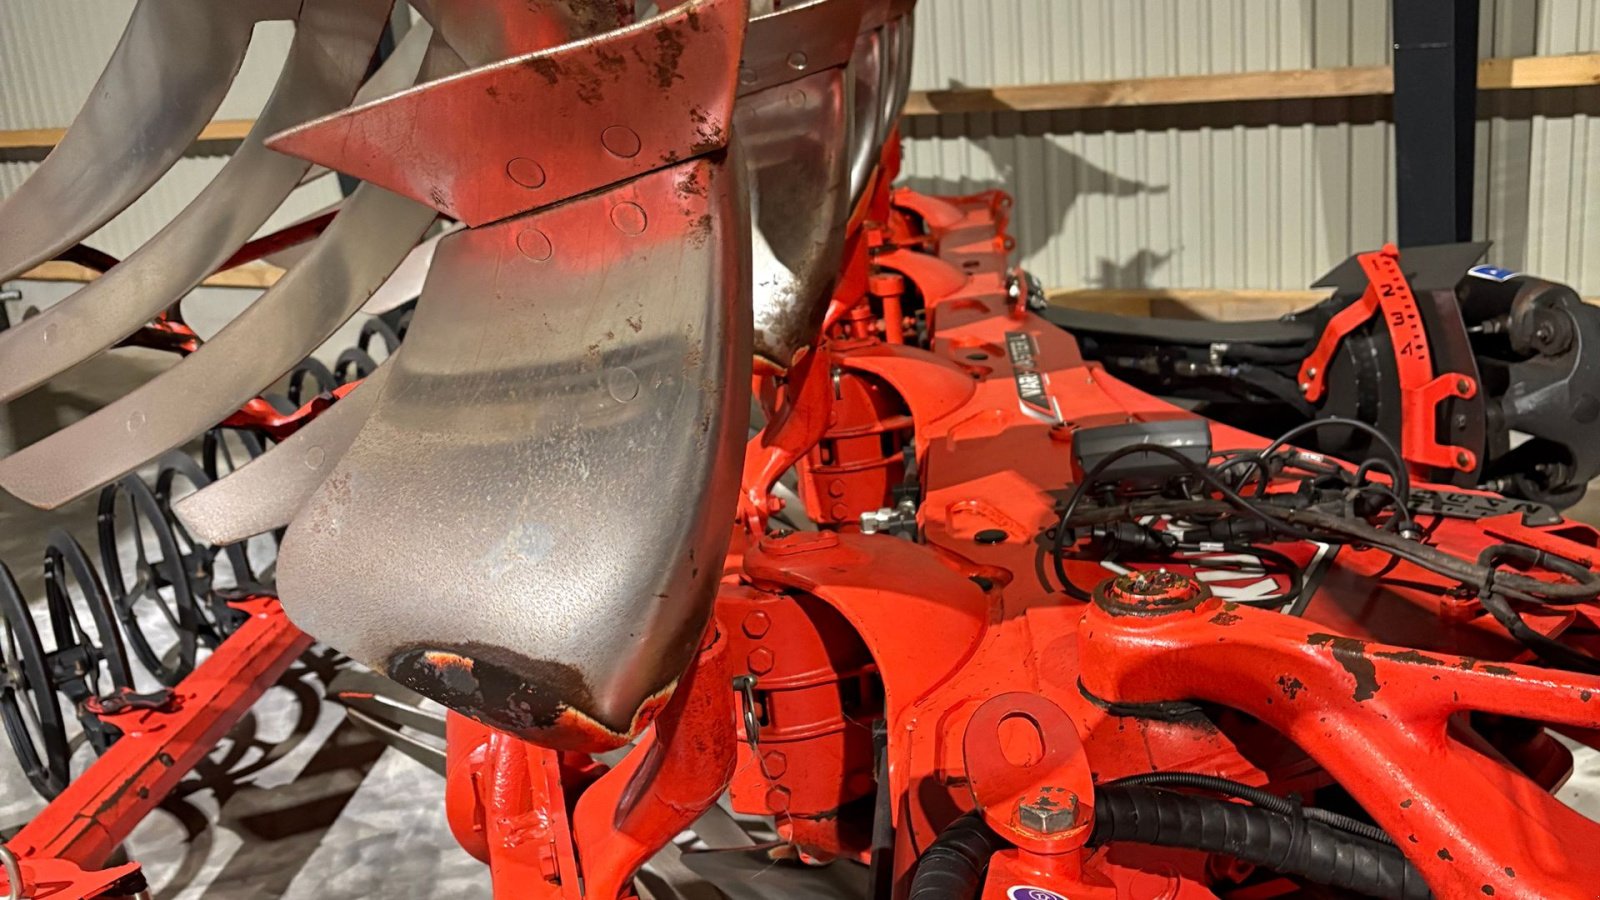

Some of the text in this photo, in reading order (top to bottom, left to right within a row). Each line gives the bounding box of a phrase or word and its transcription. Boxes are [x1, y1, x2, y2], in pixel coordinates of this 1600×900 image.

[1380, 283, 1396, 297] 2
[1390, 311, 1405, 327] 3
[1400, 341, 1413, 356] 4
